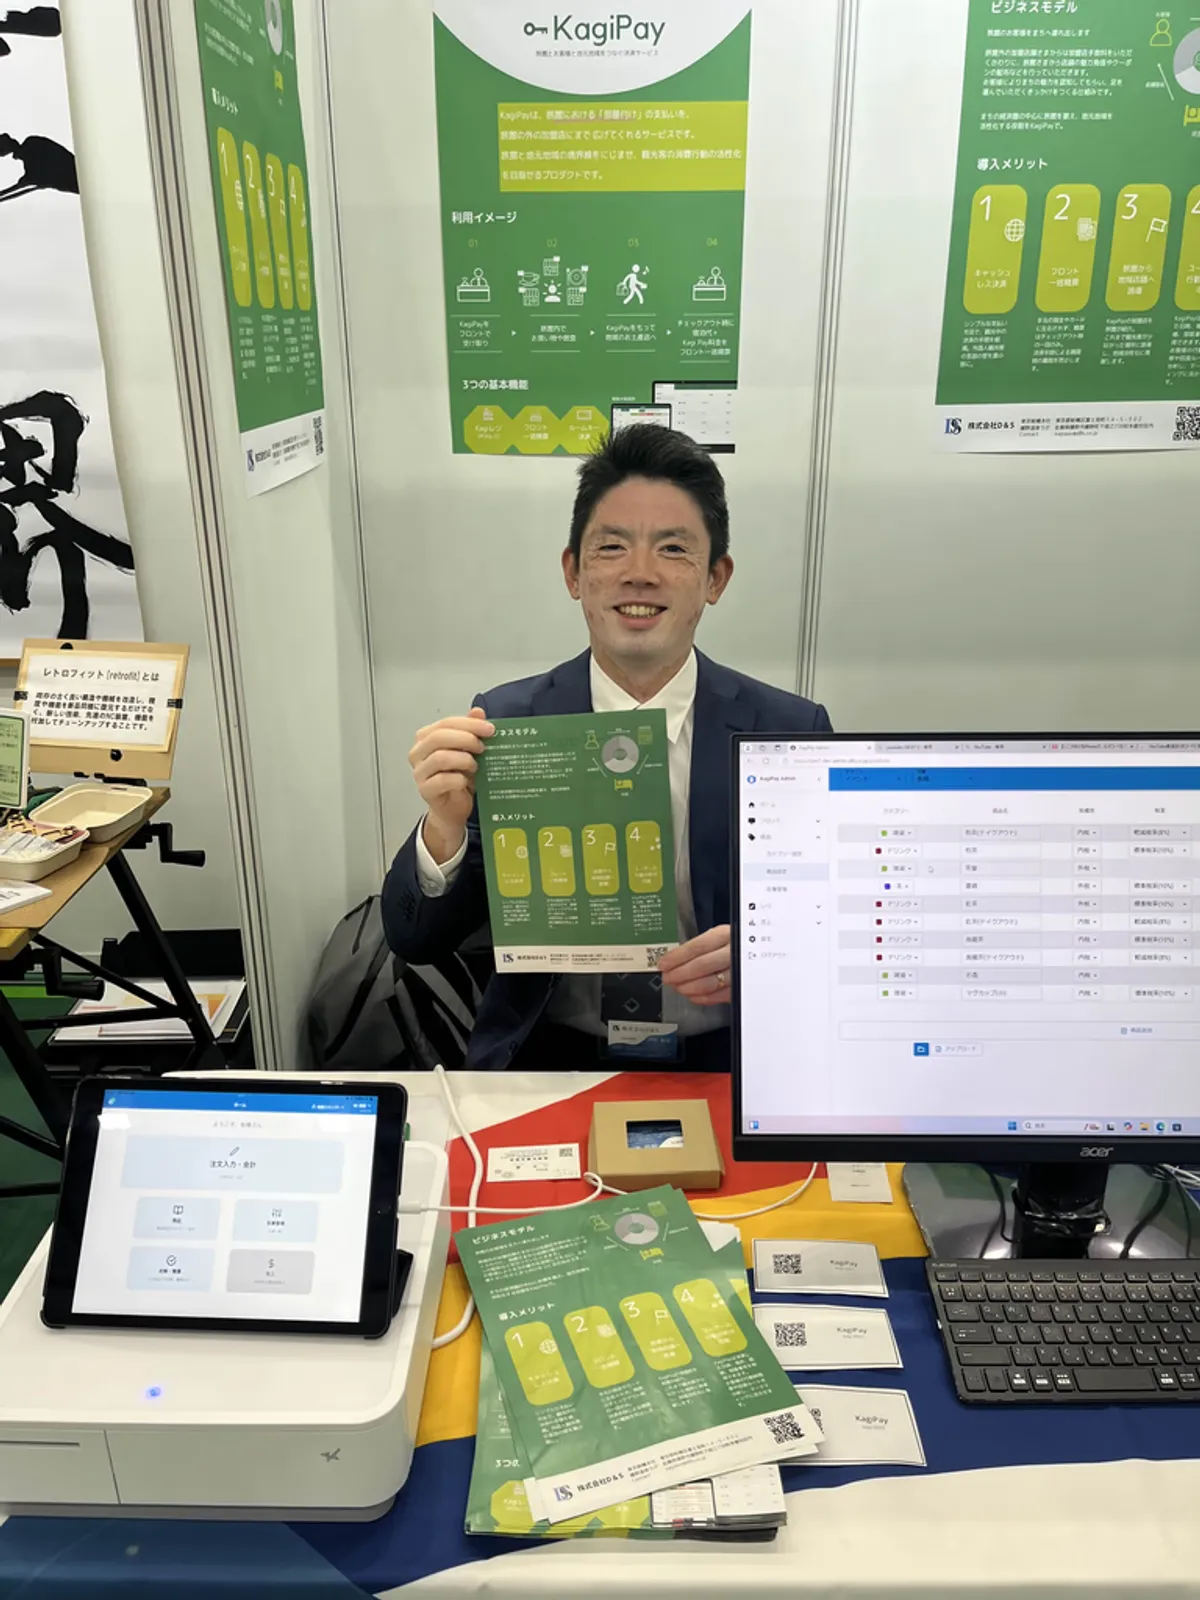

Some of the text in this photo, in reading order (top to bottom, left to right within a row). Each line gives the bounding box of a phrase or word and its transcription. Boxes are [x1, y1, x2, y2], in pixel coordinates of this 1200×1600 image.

[991, 0, 1078, 14] ビジネスモデル
[553, 15, 666, 46] KagiPay
[977, 157, 1048, 171] 導入メリット
[979, 195, 992, 221] 1
[1053, 193, 1071, 220] 2
[1121, 193, 1139, 220] 3
[451, 210, 518, 225] 利用イメージ
[462, 379, 529, 390] 3つの基本機能
[43, 667, 104, 678] レトロフィット
[142, 673, 160, 682] とは
[497, 833, 506, 848] 1
[543, 831, 554, 847] 2
[585, 829, 597, 845] 3
[629, 827, 641, 842] 4
[1080, 1146, 1113, 1157] acer
[209, 1160, 256, 1168] 注文入力・会計
[472, 1225, 535, 1245] ビジネスモデル
[680, 1288, 695, 1303] 4
[623, 1300, 641, 1318] 3
[571, 1315, 588, 1333] 2
[512, 1332, 524, 1348] 1
